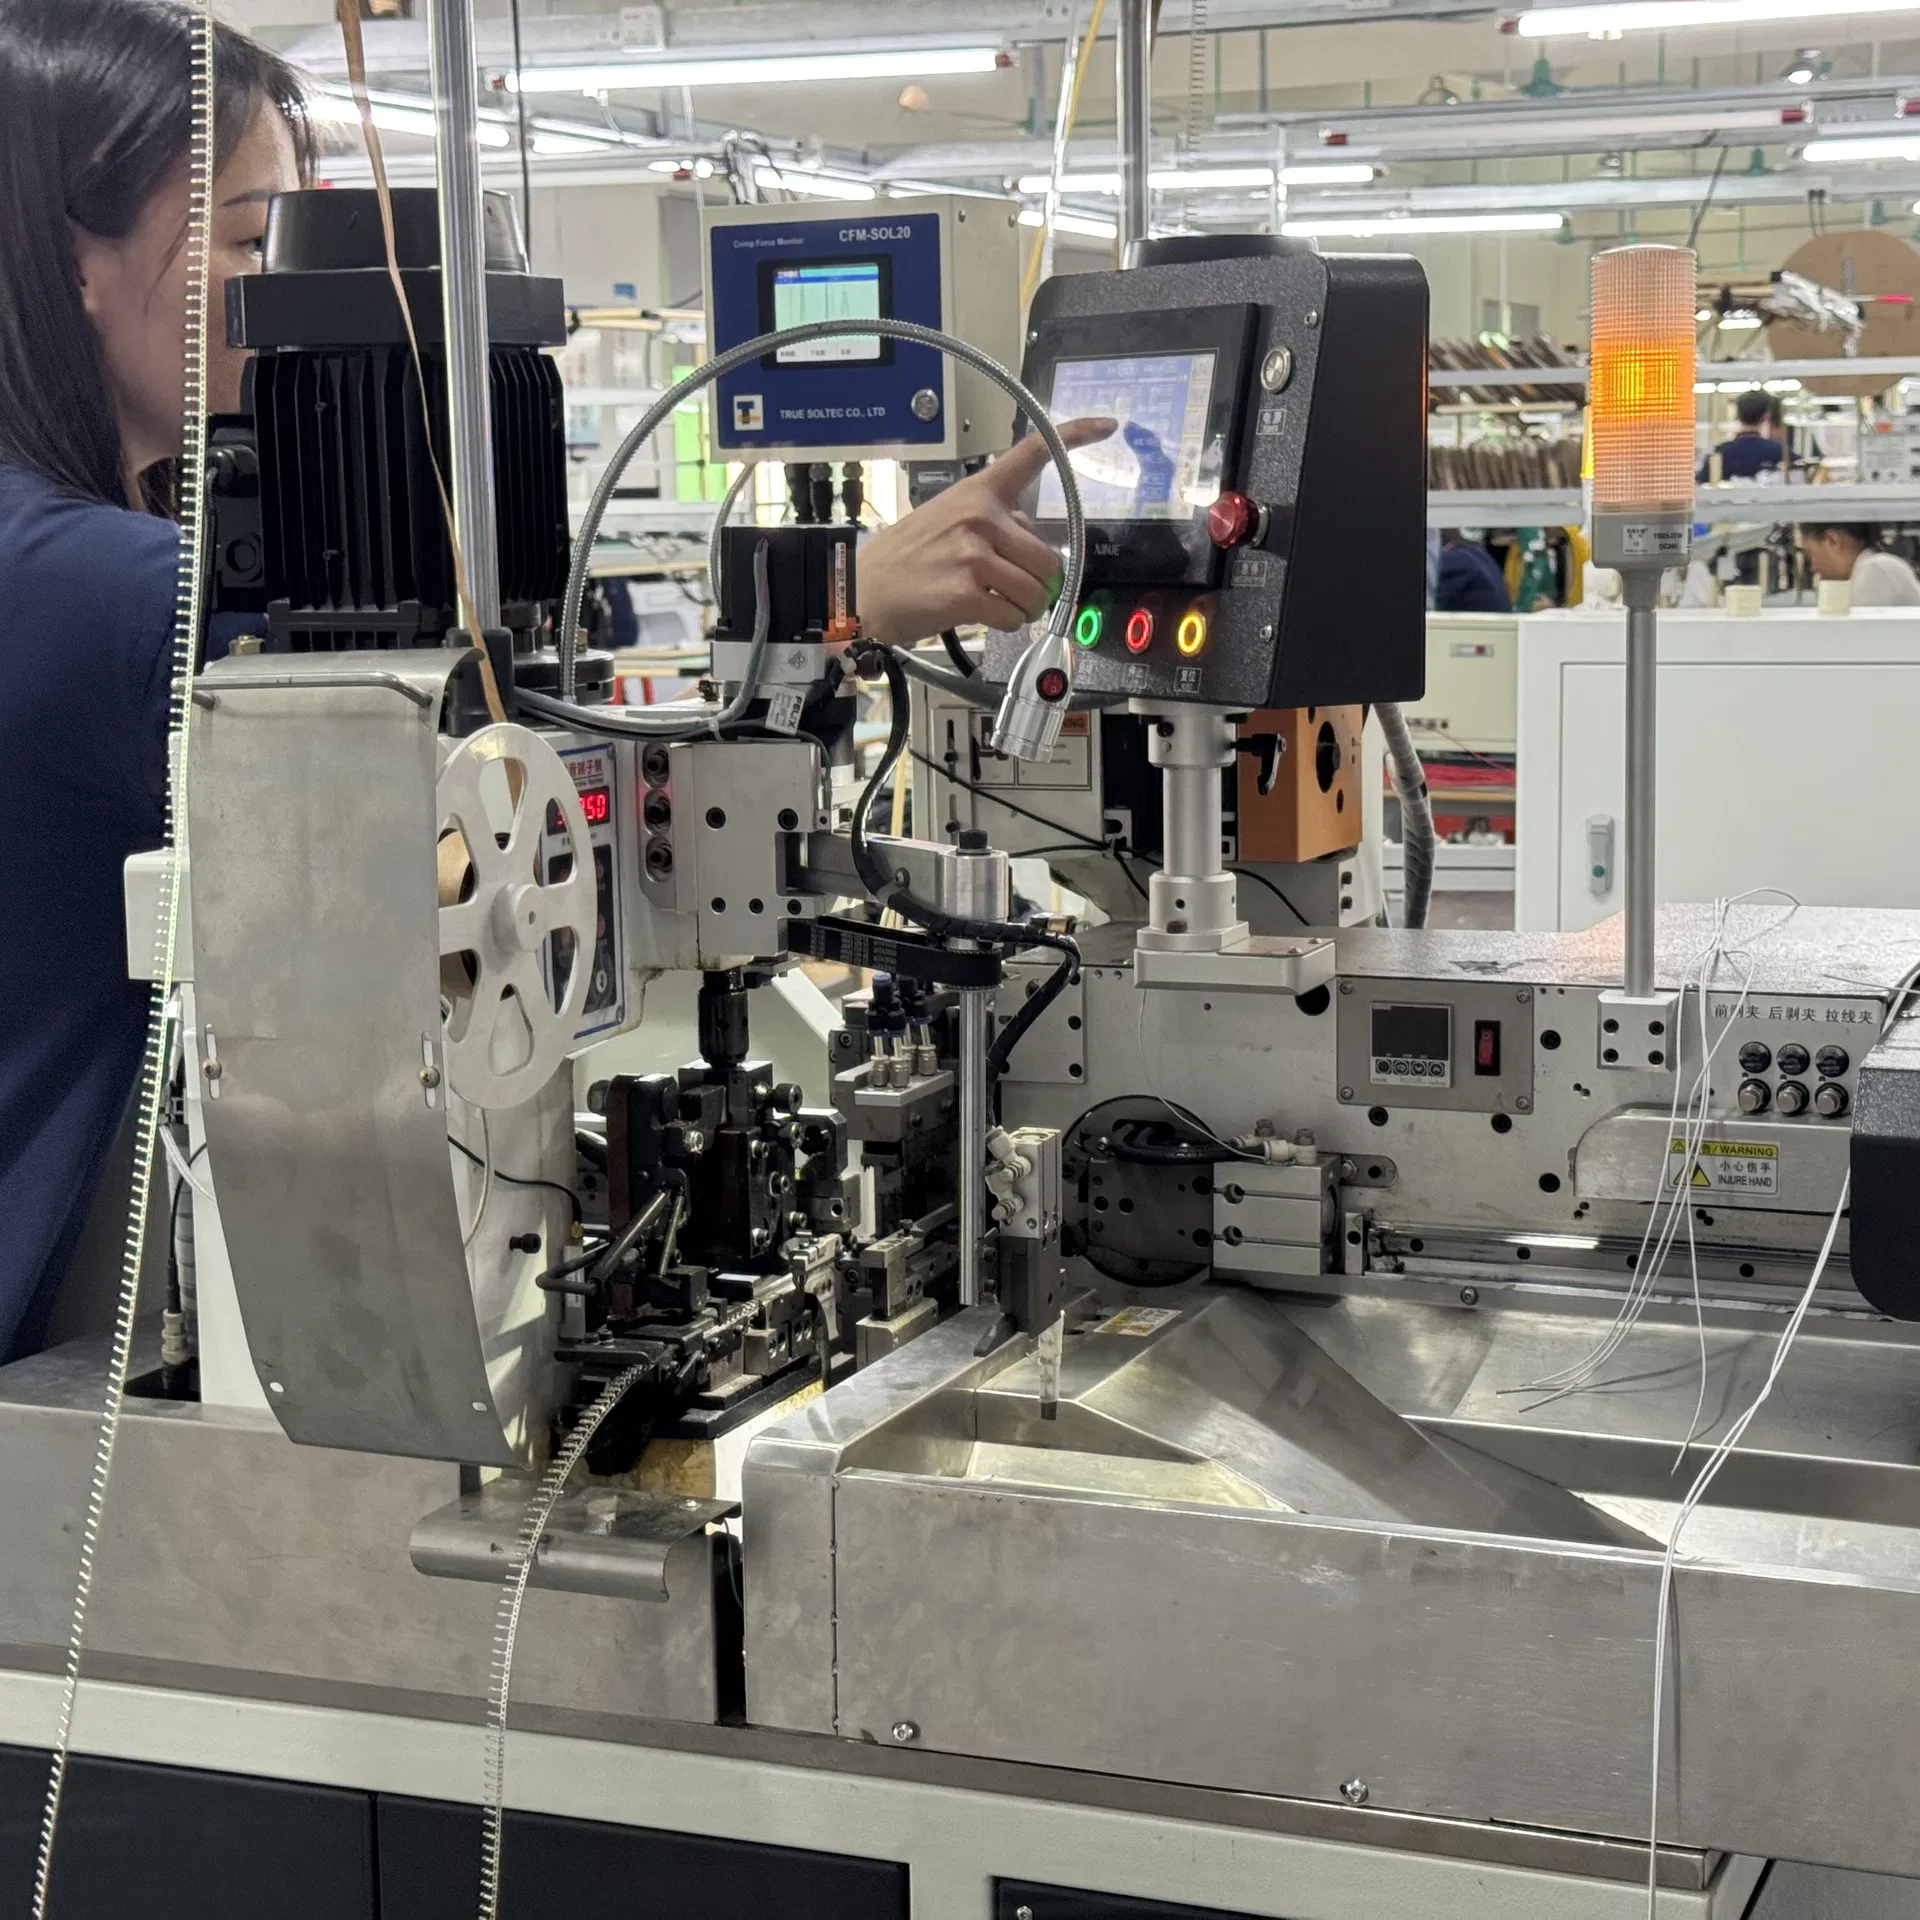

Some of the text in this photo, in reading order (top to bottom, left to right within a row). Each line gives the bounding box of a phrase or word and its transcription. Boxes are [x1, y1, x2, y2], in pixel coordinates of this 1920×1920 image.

[838, 225, 911, 242] CFM-SOL20
[780, 409, 804, 420] TRUE
[807, 408, 843, 419] SOLTEC
[867, 406, 886, 417] LTD
[1768, 1005, 1817, 1022] 后剥夹
[1825, 1008, 1874, 1025] 拉线夹
[1720, 1146, 1774, 1157] WARNING
[1720, 1160, 1771, 1174] 小心伤手
[1717, 1174, 1773, 1188] INJURE HAND
